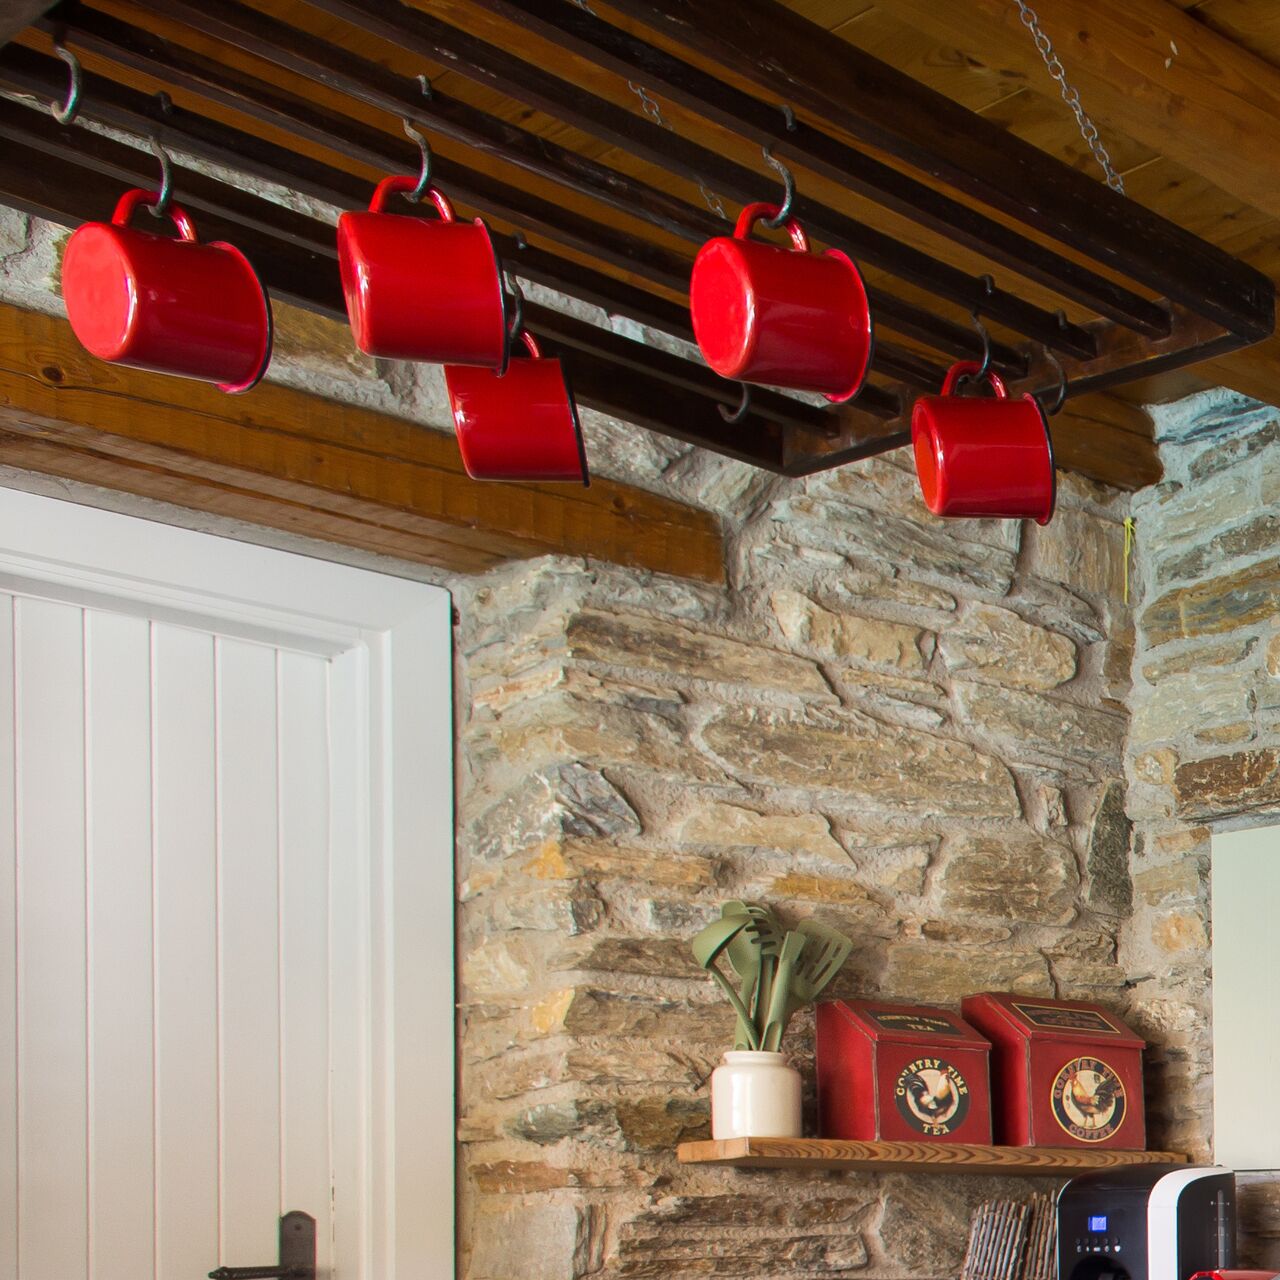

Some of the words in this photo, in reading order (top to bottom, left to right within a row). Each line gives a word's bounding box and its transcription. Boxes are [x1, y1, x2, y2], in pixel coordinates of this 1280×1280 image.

[896, 1058, 941, 1096] COUNTRY
[947, 1065, 969, 1096] TIME
[922, 1123, 951, 1136] TEA
[1068, 1124, 1114, 1139] COFFEE
